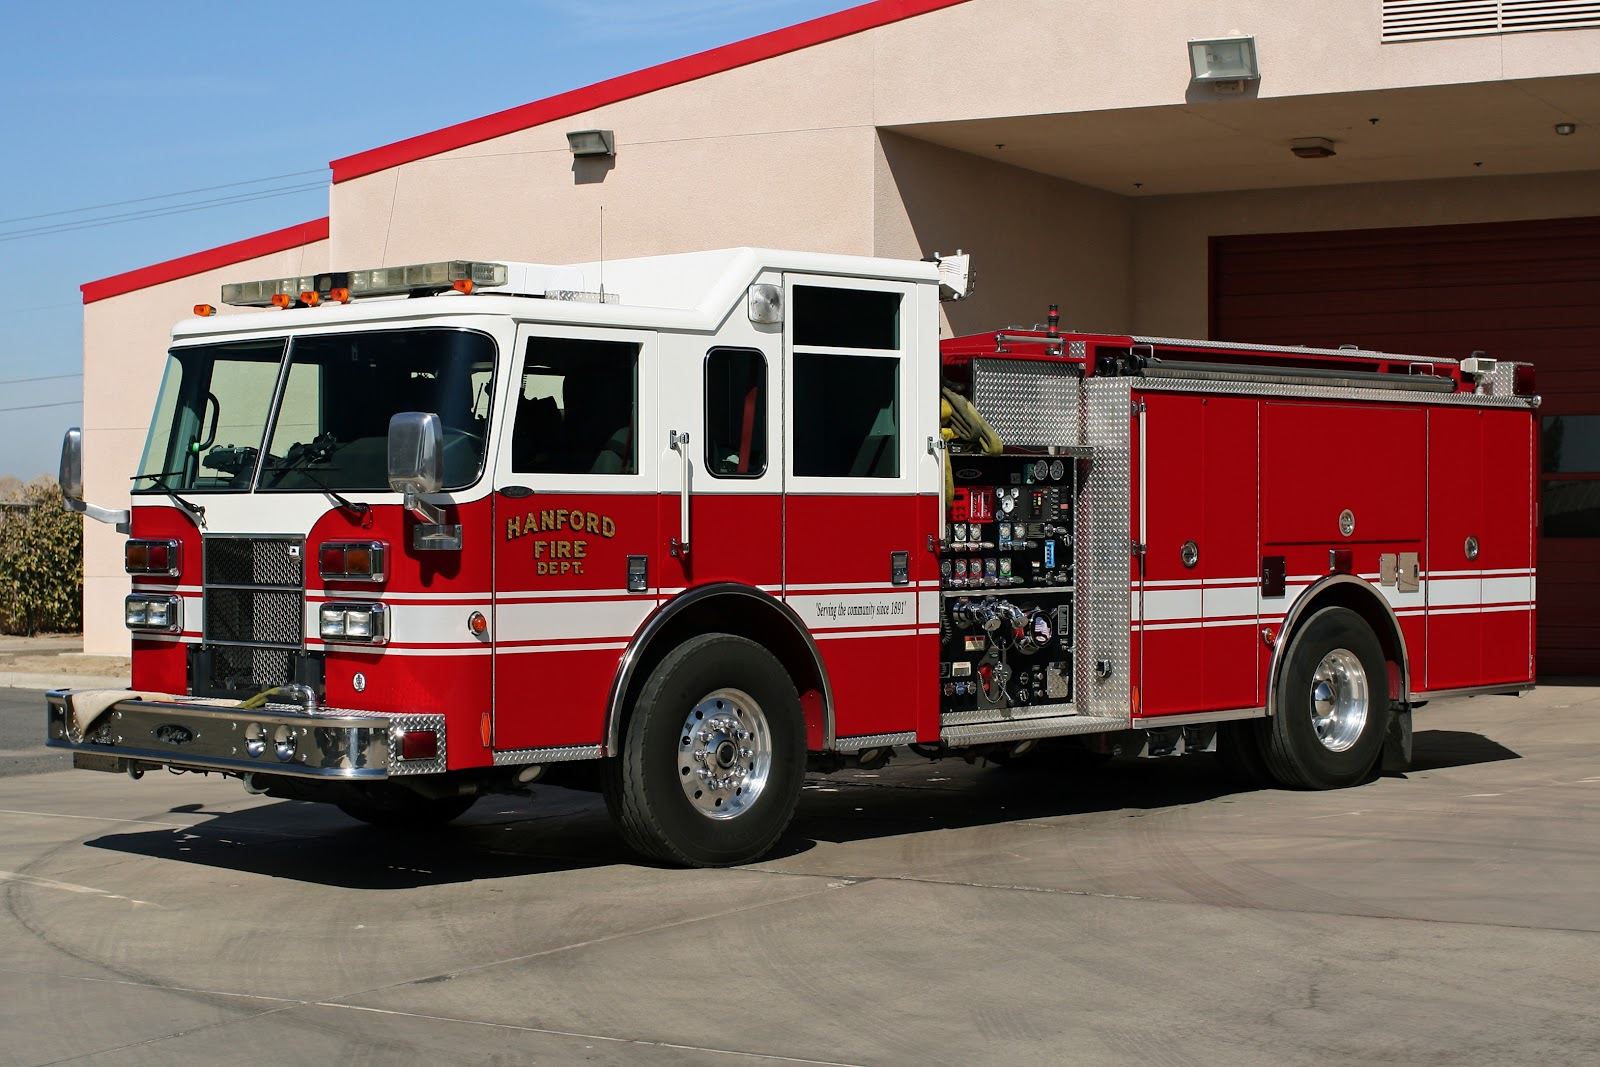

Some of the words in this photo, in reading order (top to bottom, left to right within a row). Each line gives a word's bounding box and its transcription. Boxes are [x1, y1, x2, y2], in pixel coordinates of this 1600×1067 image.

[507, 509, 616, 540] HANFORD
[534, 540, 588, 559] FIRE
[537, 561, 584, 575] DEPT.
[838, 601, 847, 616] the
[847, 602, 875, 619] community
[876, 601, 890, 615] since
